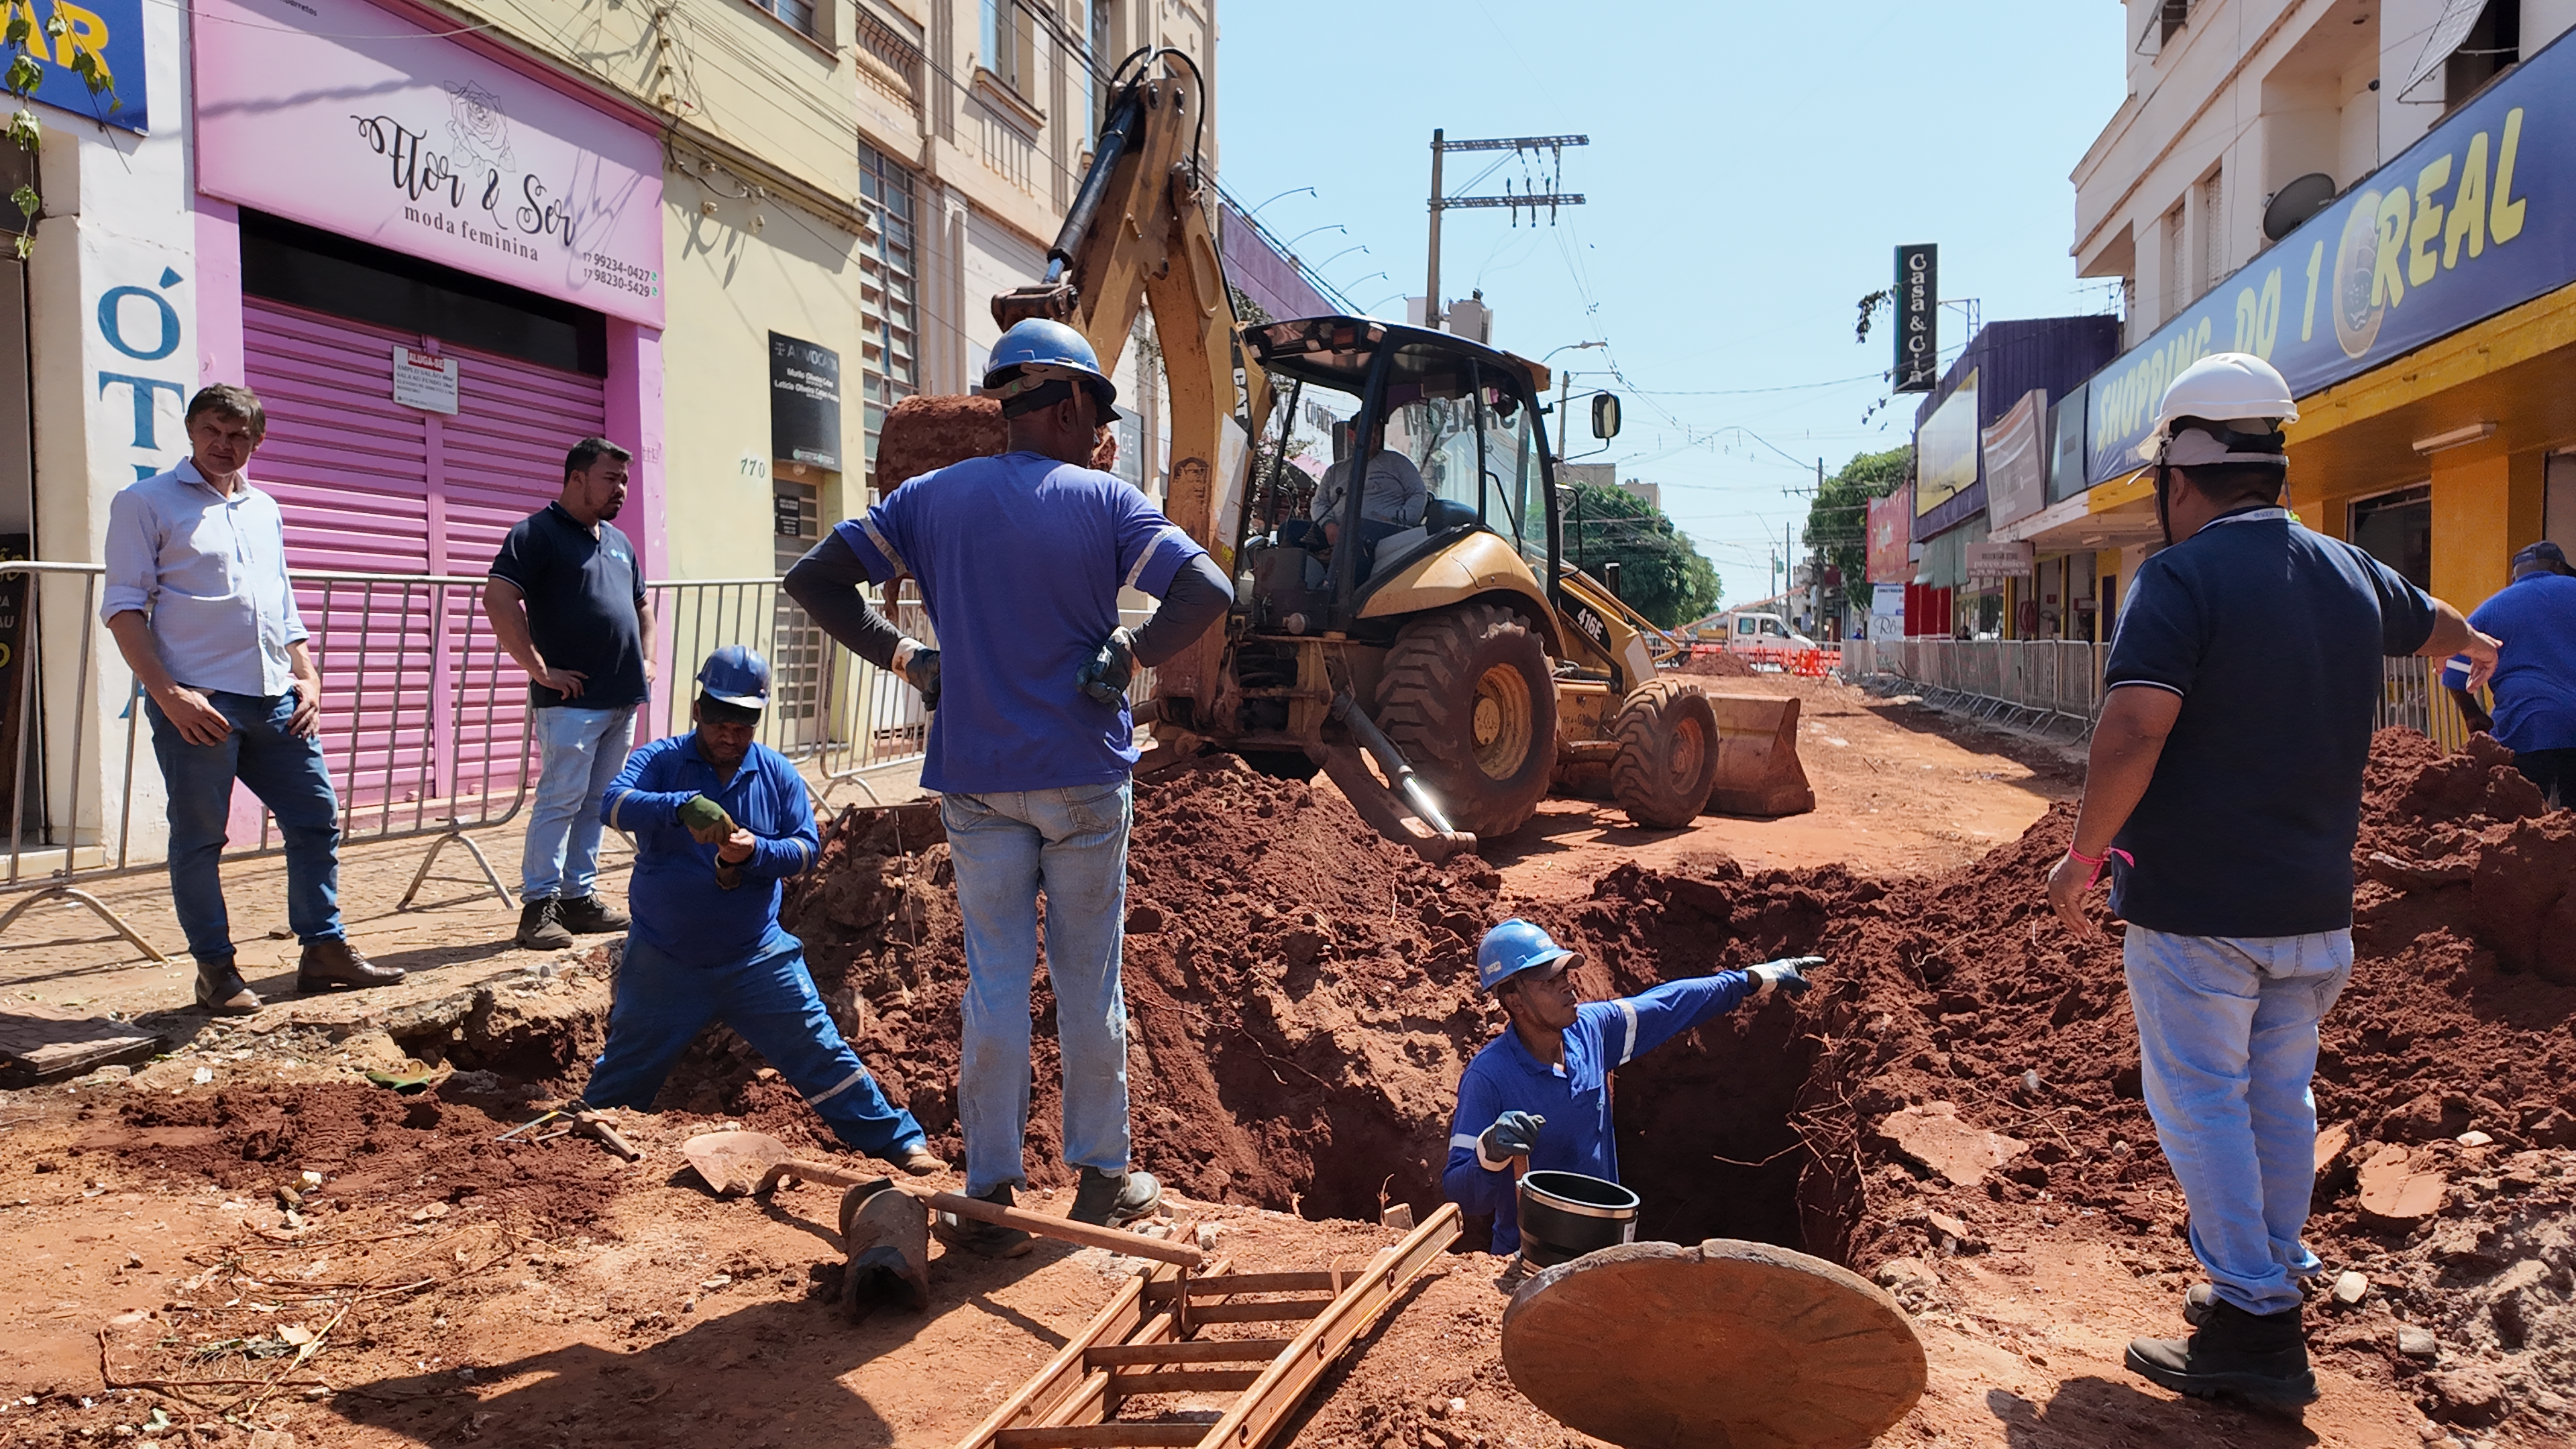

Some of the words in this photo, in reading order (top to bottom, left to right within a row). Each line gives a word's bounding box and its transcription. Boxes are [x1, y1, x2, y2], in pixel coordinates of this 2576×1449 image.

[350, 115, 465, 209] Flor
[516, 174, 576, 248] Ser
[405, 204, 455, 235] moda
[462, 220, 539, 262] feminina
[583, 252, 592, 263] 17
[594, 253, 650, 282] 99234-0427
[583, 267, 593, 279] 17
[594, 269, 650, 298] 98230-5429
[1909, 253, 1927, 312] Casa
[2097, 316, 2212, 452] SHOPPING
[2233, 266, 2282, 363] DO
[2302, 240, 2323, 343] 1
[2371, 107, 2527, 309] REAL
[1909, 315, 1927, 332] &
[409, 352, 444, 369] ALUGA-SE
[1909, 335, 1926, 383] Cia
[1233, 368, 1248, 419] CAT
[741, 457, 765, 478] 770
[1577, 608, 1604, 641] 416E
